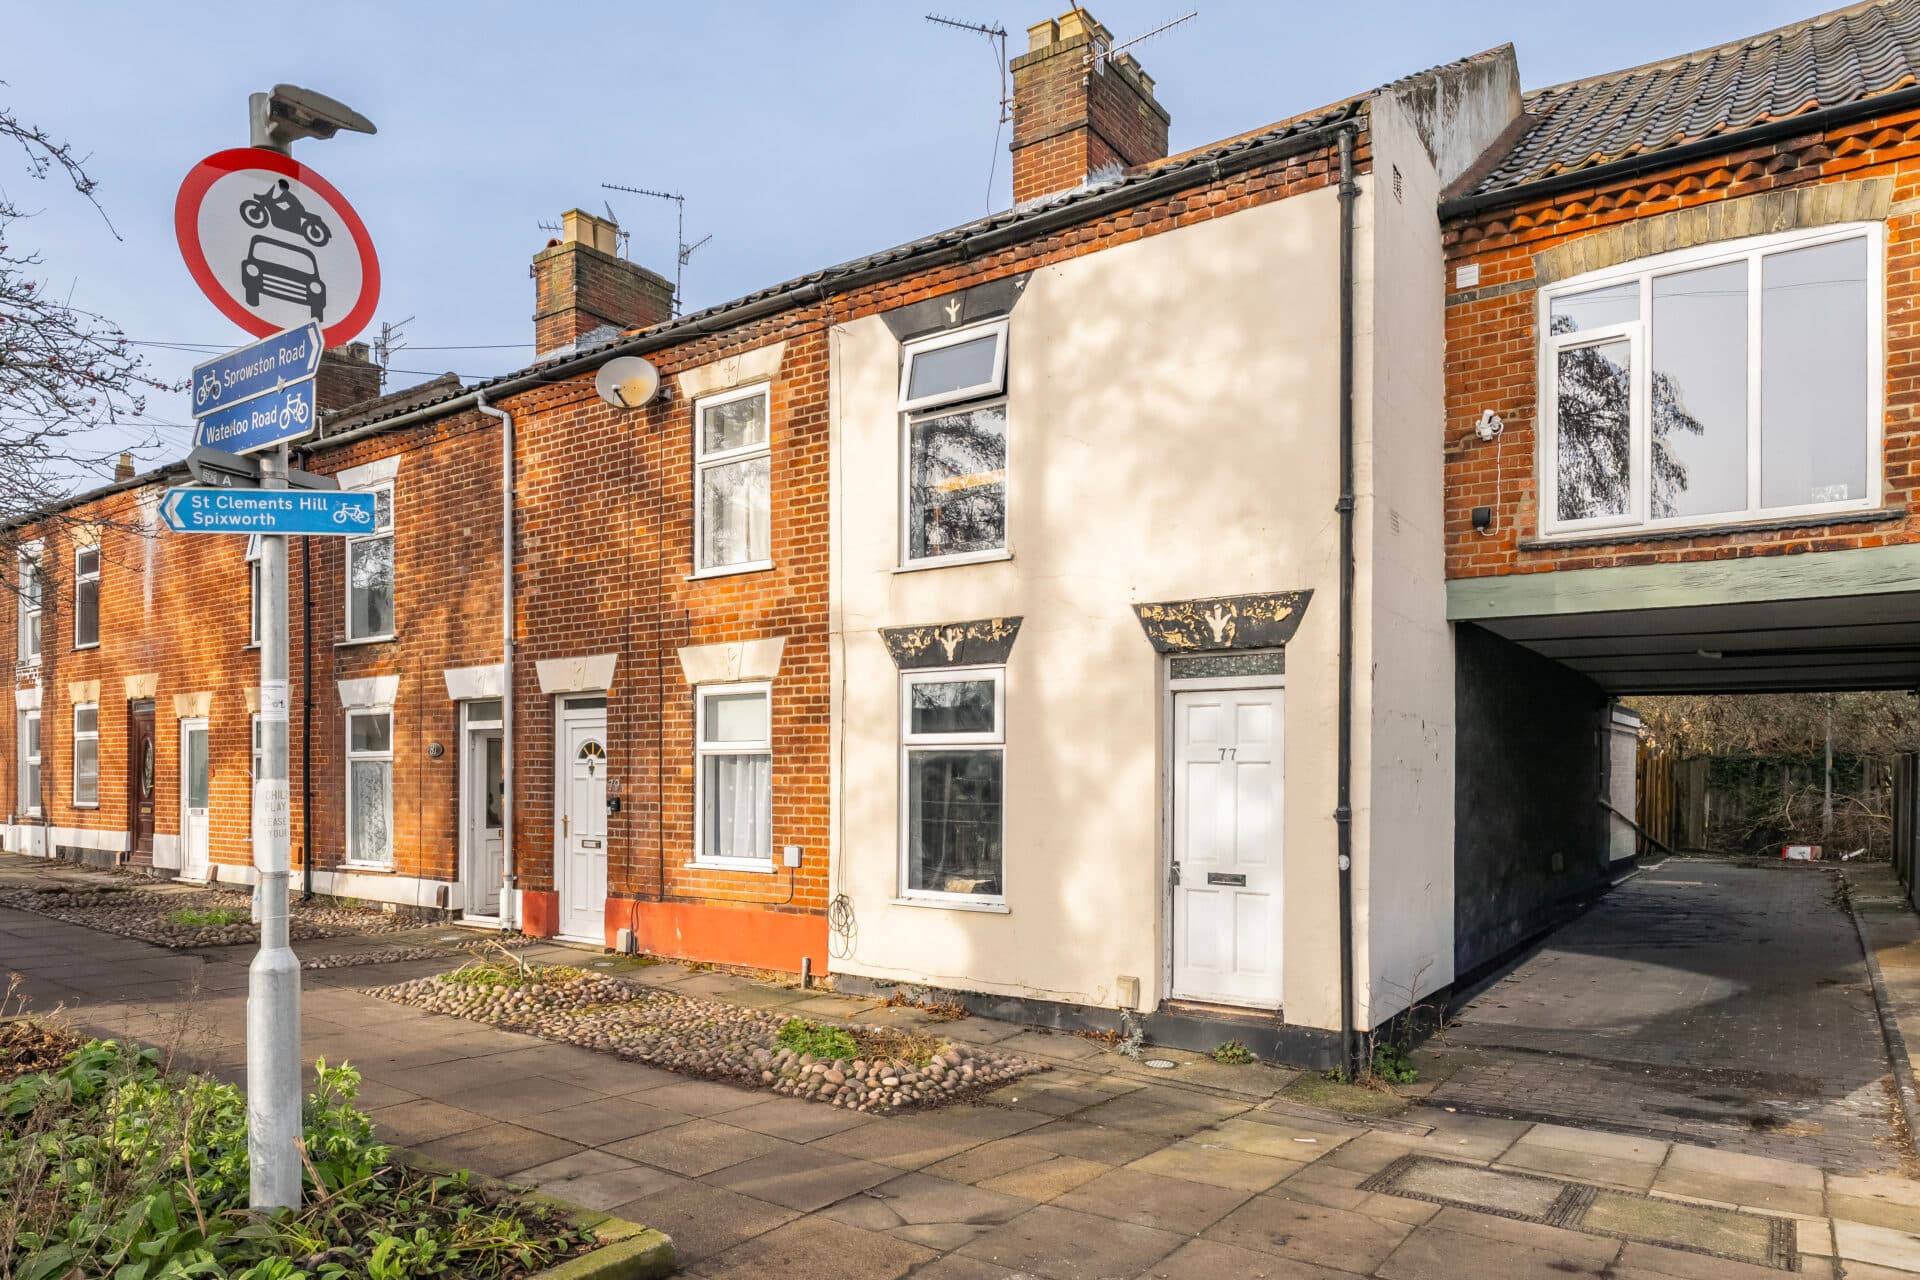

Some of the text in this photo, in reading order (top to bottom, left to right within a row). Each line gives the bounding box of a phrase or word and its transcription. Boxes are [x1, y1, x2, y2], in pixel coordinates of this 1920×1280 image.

[223, 341, 305, 388] Sprowston Road
[206, 404, 277, 444] Waterloo Road
[191, 495, 328, 511] St Clements Hill
[192, 511, 276, 527] Spixworth
[1218, 747, 1237, 761] 77
